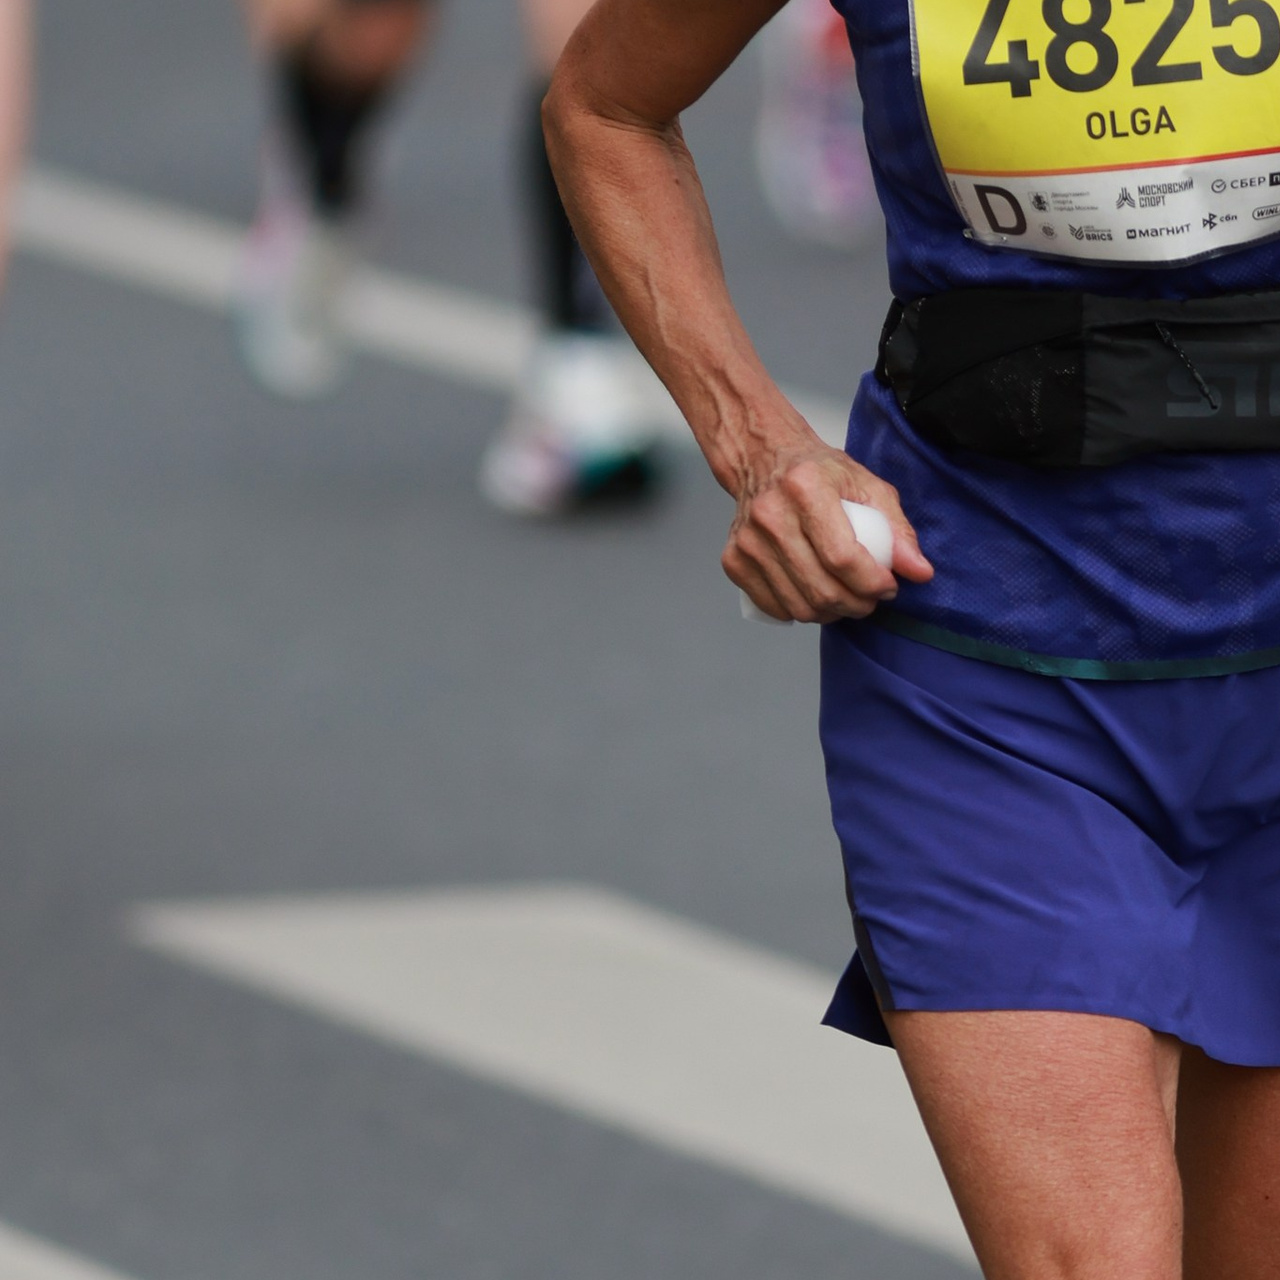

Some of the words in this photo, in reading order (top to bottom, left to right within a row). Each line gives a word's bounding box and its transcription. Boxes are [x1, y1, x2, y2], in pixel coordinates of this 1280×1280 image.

[1085, 105, 1177, 140] OLGA
[1137, 177, 1194, 196] МОСКОВСКИЙ
[1230, 176, 1266, 189] СБЕР
[973, 183, 1028, 236] D
[1138, 195, 1166, 208] СПОРТ
[1085, 232, 1113, 241] BRICS
